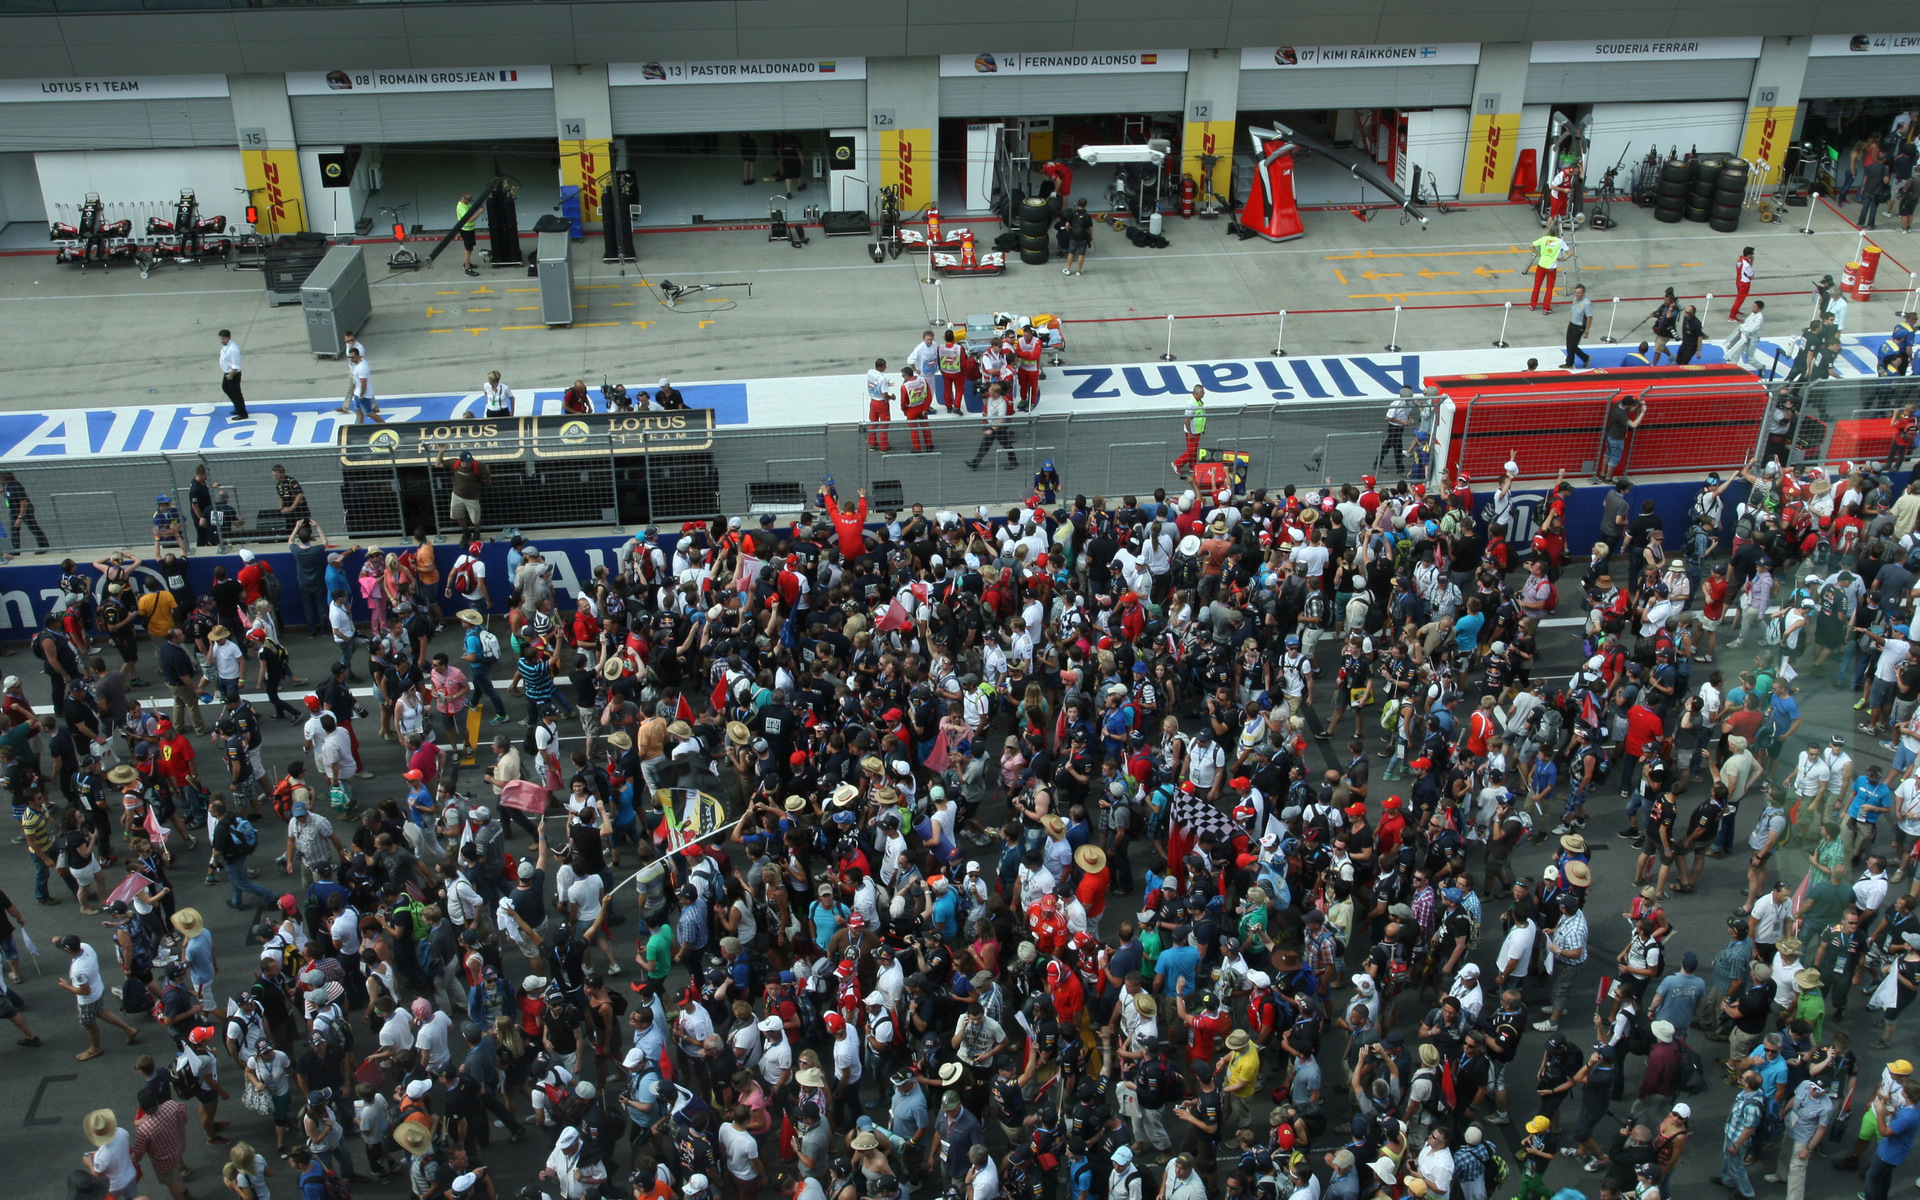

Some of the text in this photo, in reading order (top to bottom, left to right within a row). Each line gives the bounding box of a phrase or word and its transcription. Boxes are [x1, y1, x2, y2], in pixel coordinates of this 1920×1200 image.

[1595, 42, 1699, 54] SCUDERIA FERRARI
[1873, 37, 1920, 47] 44 LEWI
[1301, 47, 1417, 60] 07 KIMI RÄIKKÖNEN
[1003, 55, 1137, 67] 14 FERNANDO ALONSO
[668, 63, 815, 76] 13 PASTOR MALDONADO
[355, 71, 496, 85] 08 ROMAIN GROSJEAN
[42, 81, 139, 93] LOTUS F1 TEAM
[1760, 91, 1774, 102] 10
[1484, 98, 1494, 109] 11
[1194, 106, 1208, 117] 12
[873, 114, 893, 125] 12a
[565, 124, 581, 135] 14
[246, 133, 261, 145] 15
[1481, 125, 1501, 183] DHL
[898, 140, 912, 200] DHL
[579, 151, 598, 212] DHL
[262, 161, 286, 223] DHL
[1062, 355, 1424, 400] Allianz
[608, 415, 687, 431] LOTUS
[418, 424, 498, 440] LOTUS
